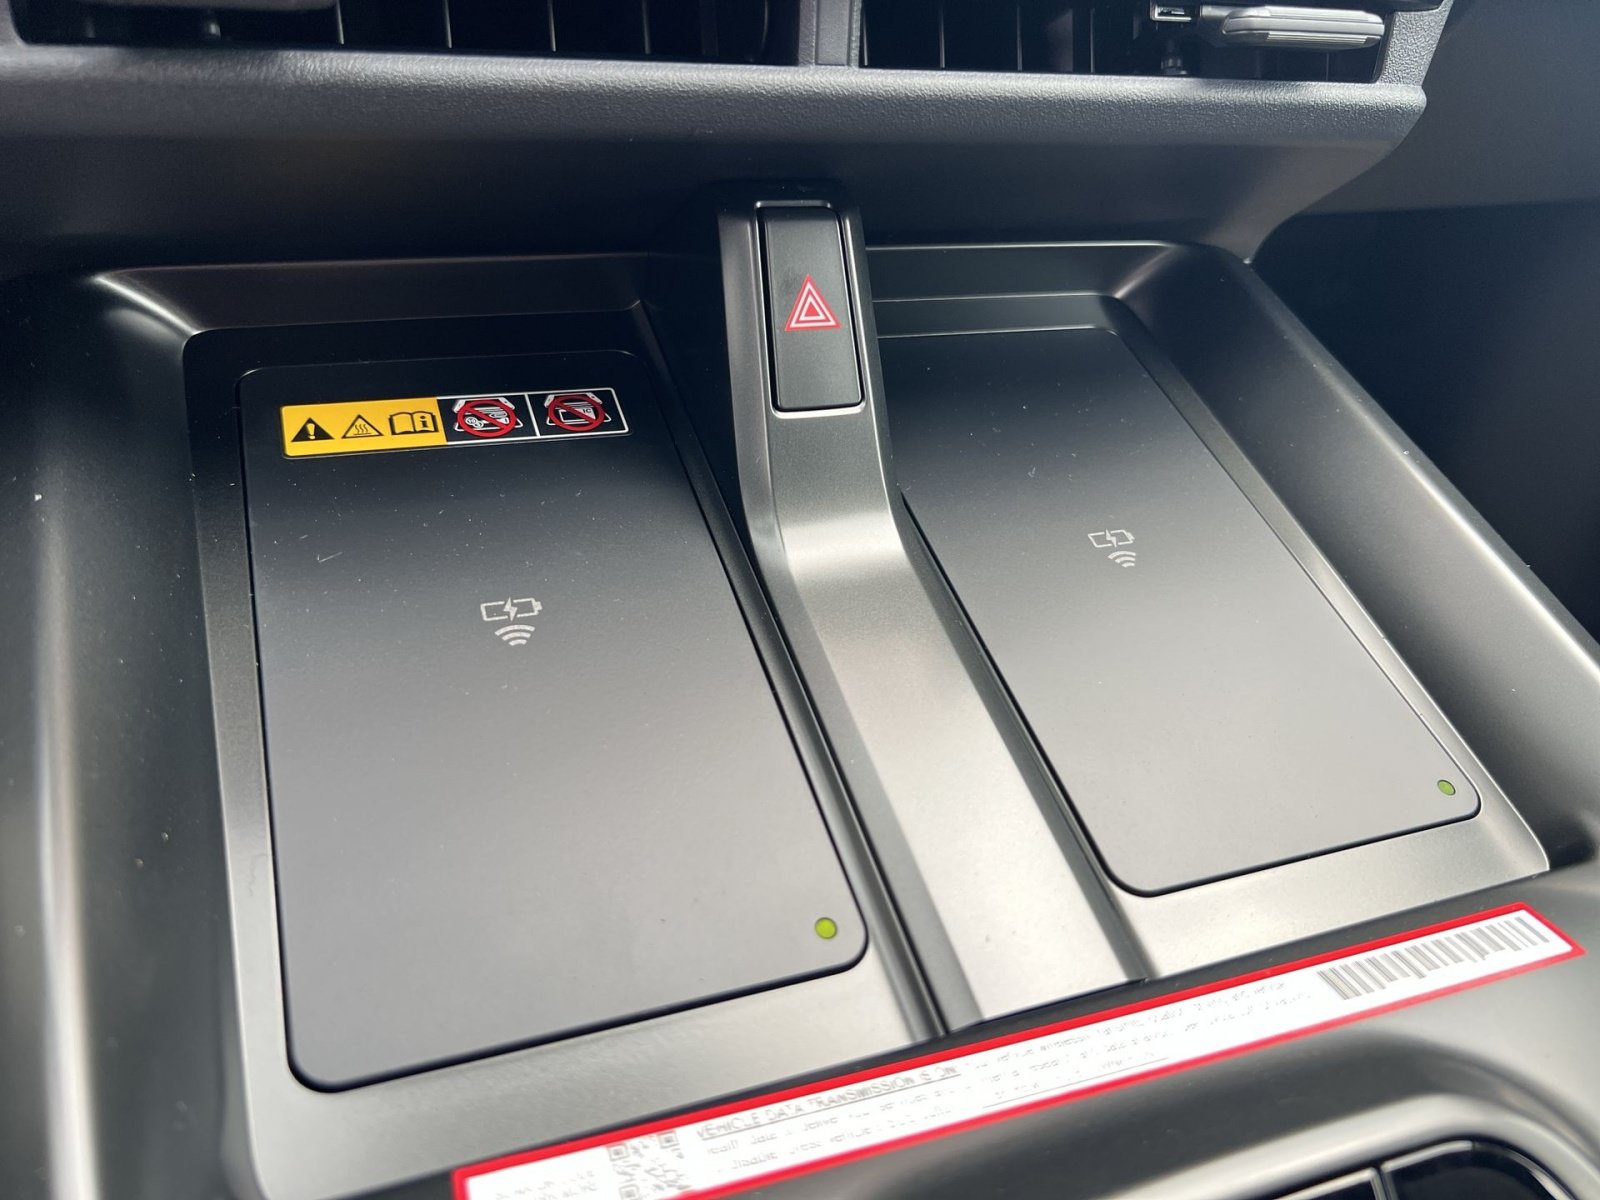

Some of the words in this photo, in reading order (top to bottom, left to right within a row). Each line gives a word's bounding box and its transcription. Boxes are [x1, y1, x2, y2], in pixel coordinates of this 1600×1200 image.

[696, 1112, 761, 1139] VEHICLE
[764, 1103, 804, 1121] DATA
[807, 1076, 916, 1107] TRANSMISSION
